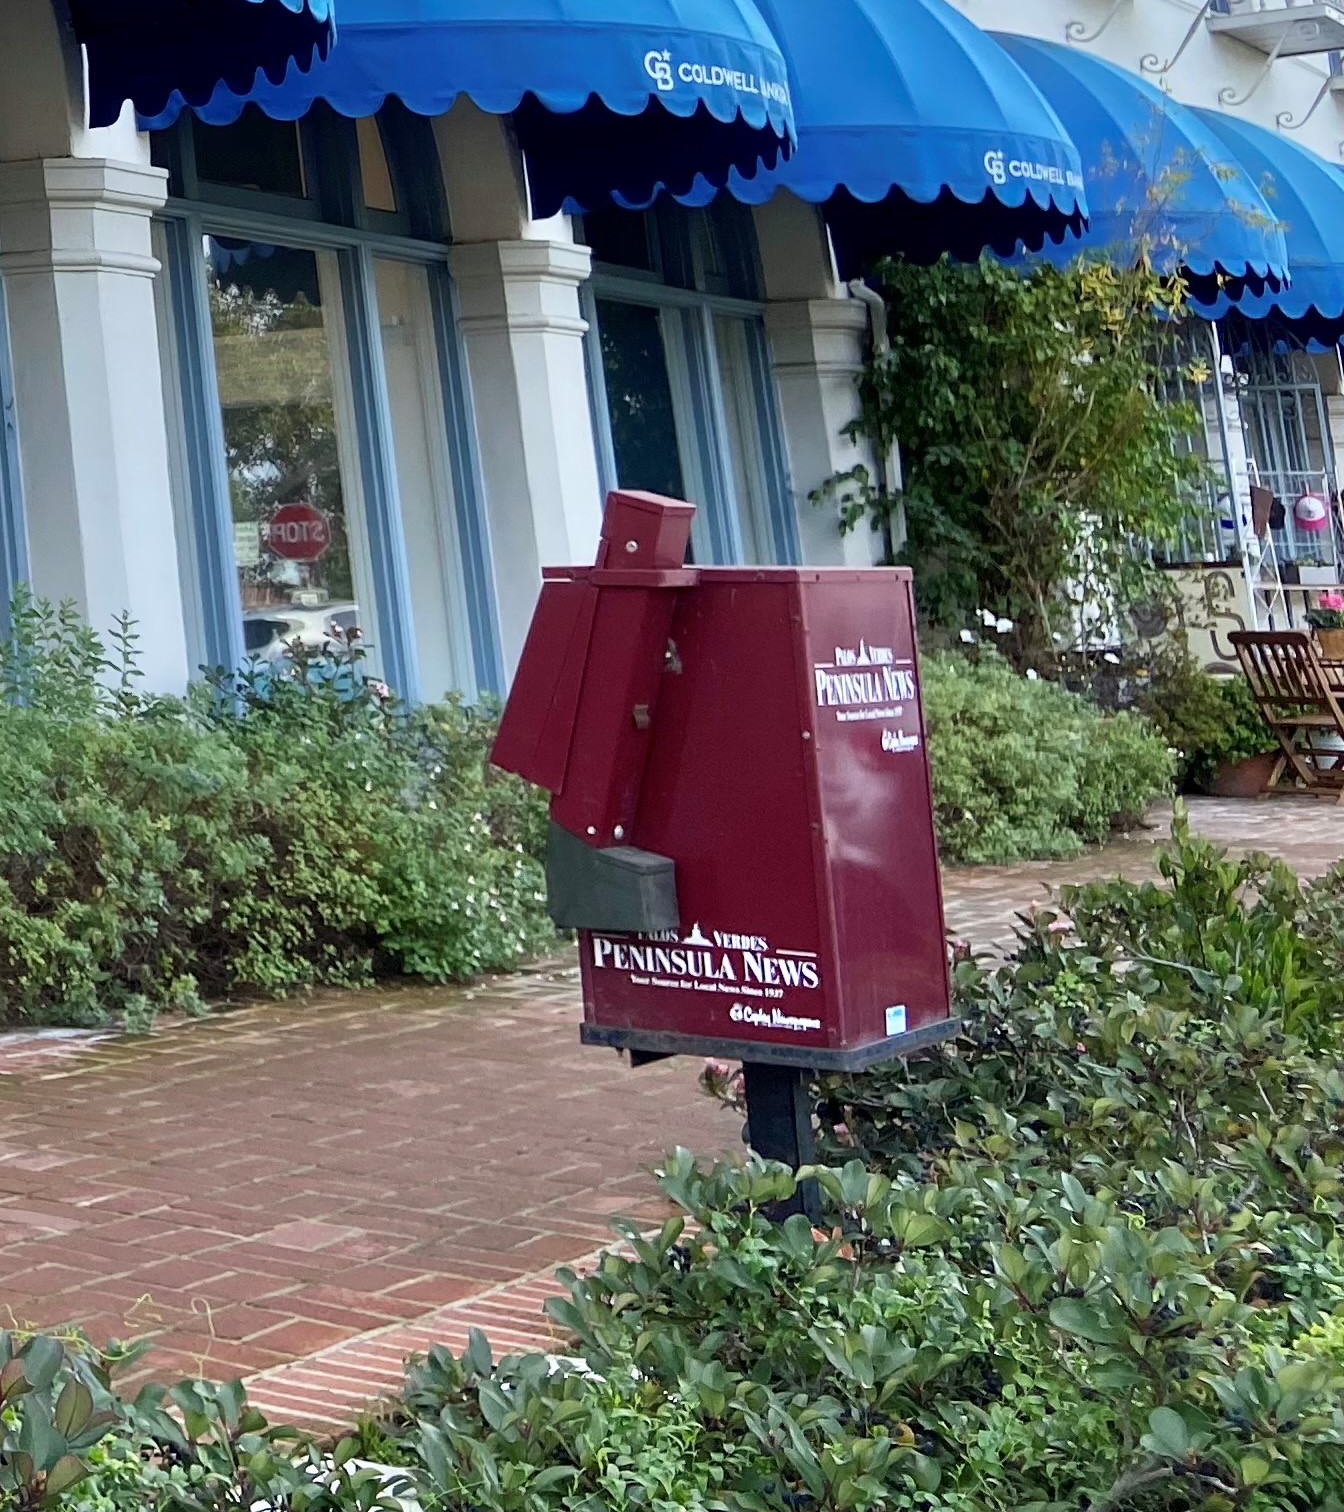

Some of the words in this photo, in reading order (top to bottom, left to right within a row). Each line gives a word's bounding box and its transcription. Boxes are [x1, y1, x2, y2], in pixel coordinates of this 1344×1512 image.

[678, 62, 759, 95] COLDWELL
[1008, 159, 1065, 185] COLDWELL
[814, 669, 883, 706] PENINSULA
[882, 665, 916, 702] NEWS
[713, 929, 769, 951] VERDES
[593, 937, 738, 982] PENINSULA
[742, 951, 820, 990] NEWS
